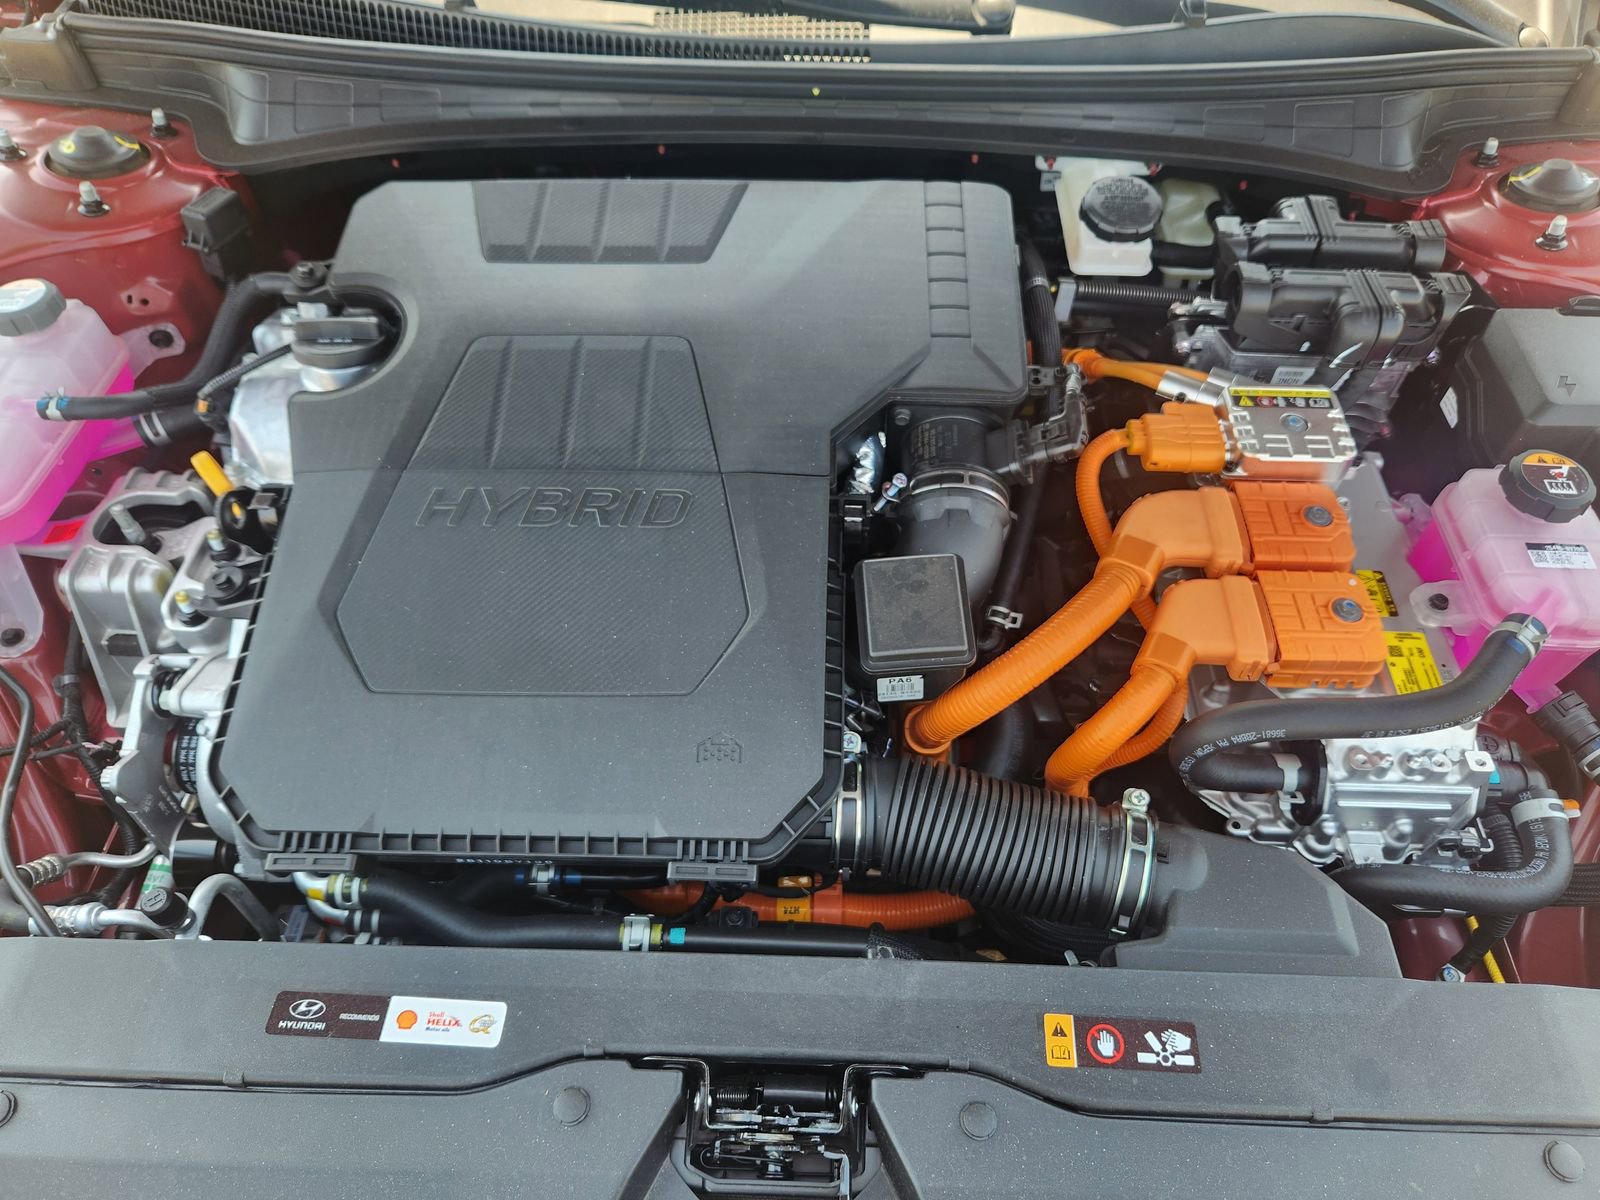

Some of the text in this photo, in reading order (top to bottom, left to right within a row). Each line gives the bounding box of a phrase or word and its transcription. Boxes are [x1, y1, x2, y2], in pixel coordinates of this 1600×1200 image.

[415, 486, 694, 528] HYBRID
[278, 1020, 327, 1031] HYUNDAI
[426, 1018, 462, 1027] HELIX
